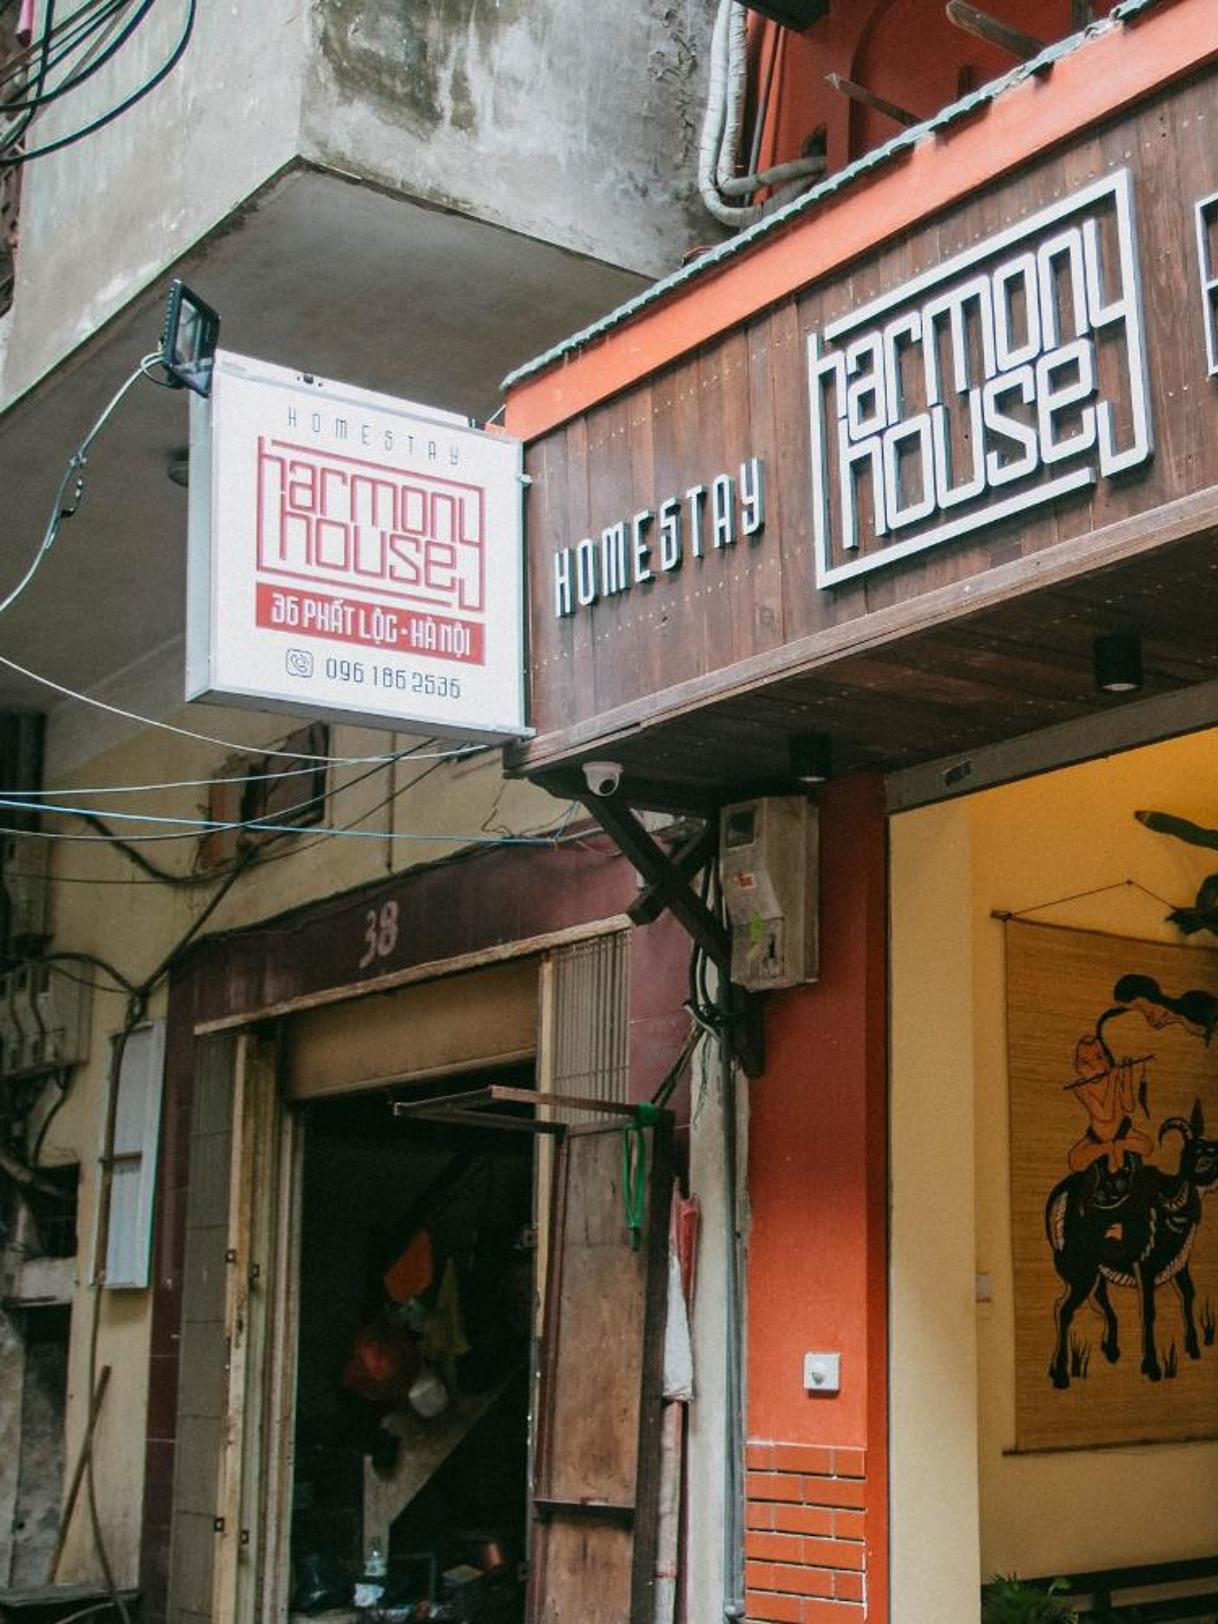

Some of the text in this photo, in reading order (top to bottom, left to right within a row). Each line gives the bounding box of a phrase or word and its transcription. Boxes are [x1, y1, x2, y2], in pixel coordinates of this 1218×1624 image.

[808, 200, 1152, 450] harmony
[287, 405, 460, 466] HOMESTAY
[838, 338, 1097, 550] house
[258, 440, 485, 548] harmony
[279, 493, 458, 592] house
[553, 456, 765, 619] HOMESTAY
[271, 591, 299, 624] 36
[303, 598, 354, 636] PHẤT
[358, 606, 398, 644] LỘC
[411, 616, 437, 650] HÀ
[325, 657, 462, 700] 096 186 2536
[359, 900, 398, 968] 38
